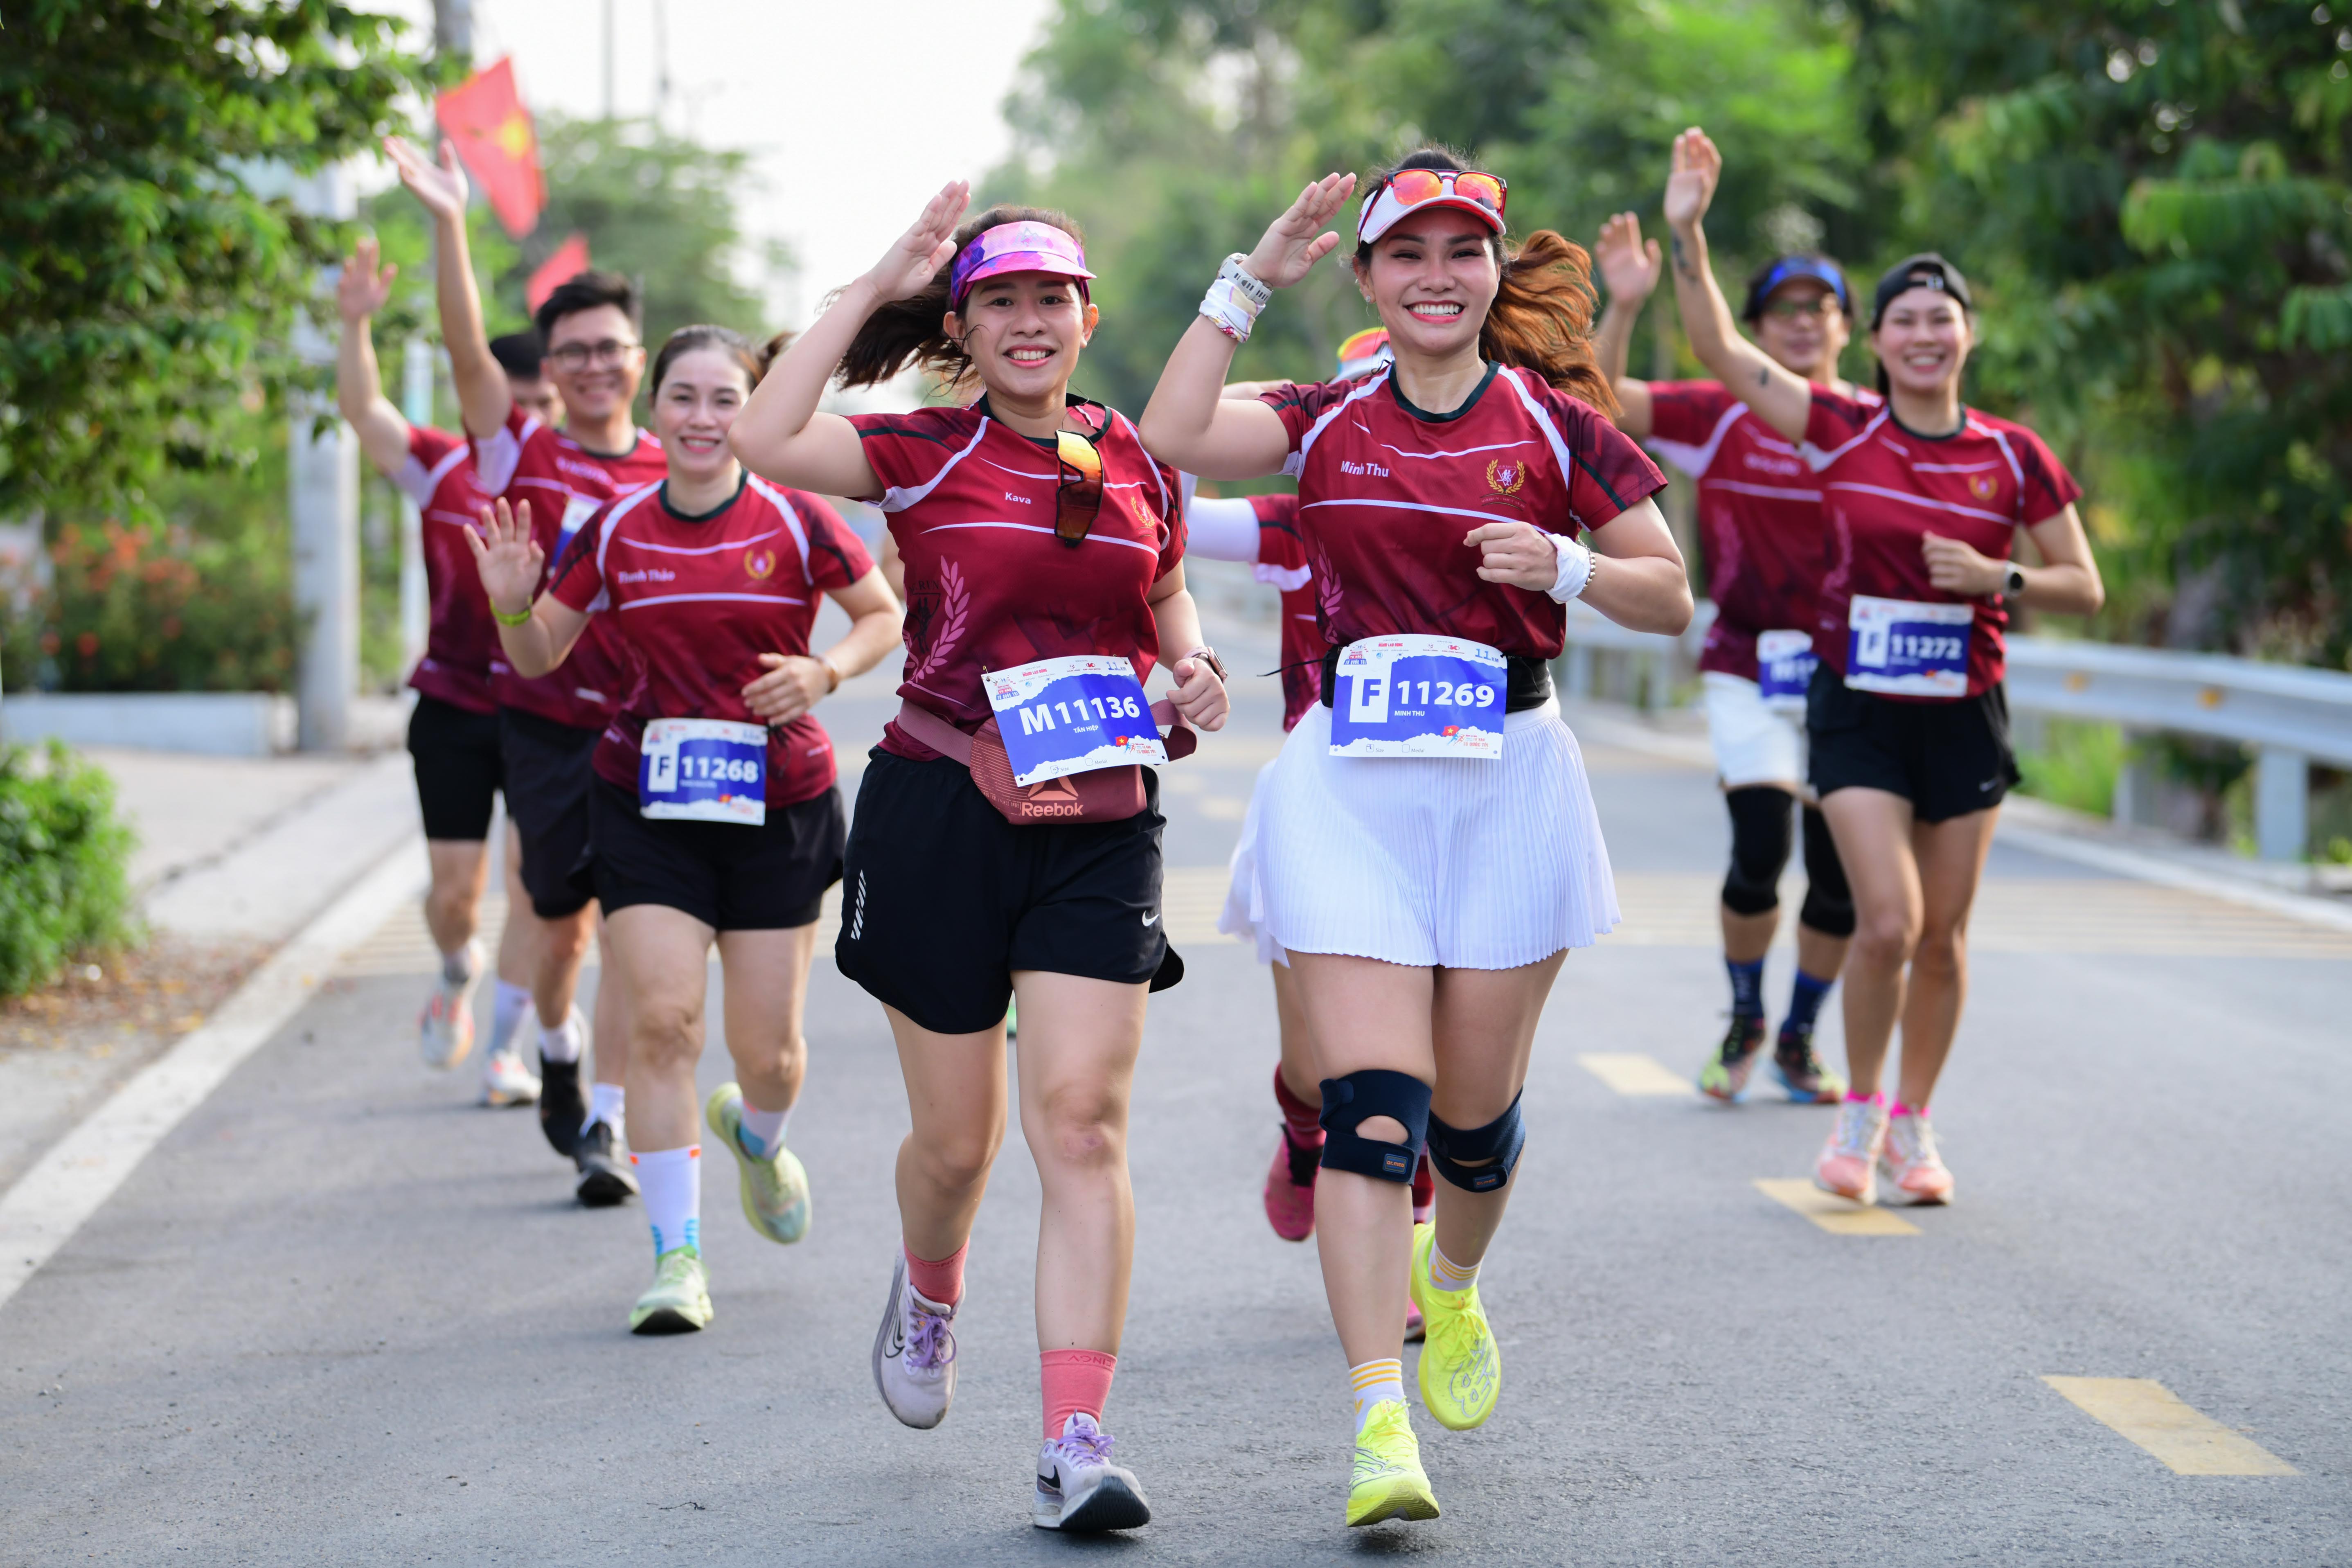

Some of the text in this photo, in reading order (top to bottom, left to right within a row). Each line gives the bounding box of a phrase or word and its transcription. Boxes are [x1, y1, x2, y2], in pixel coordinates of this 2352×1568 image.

[1340, 460, 1389, 477] Minh Thu
[1005, 492, 1031, 505] Kava
[1868, 632, 1963, 660] F 11272
[1362, 679, 1495, 707] F 11269
[1019, 696, 1140, 736] M11136
[659, 755, 758, 783] F 11268
[1022, 802, 1084, 817] Reebok
